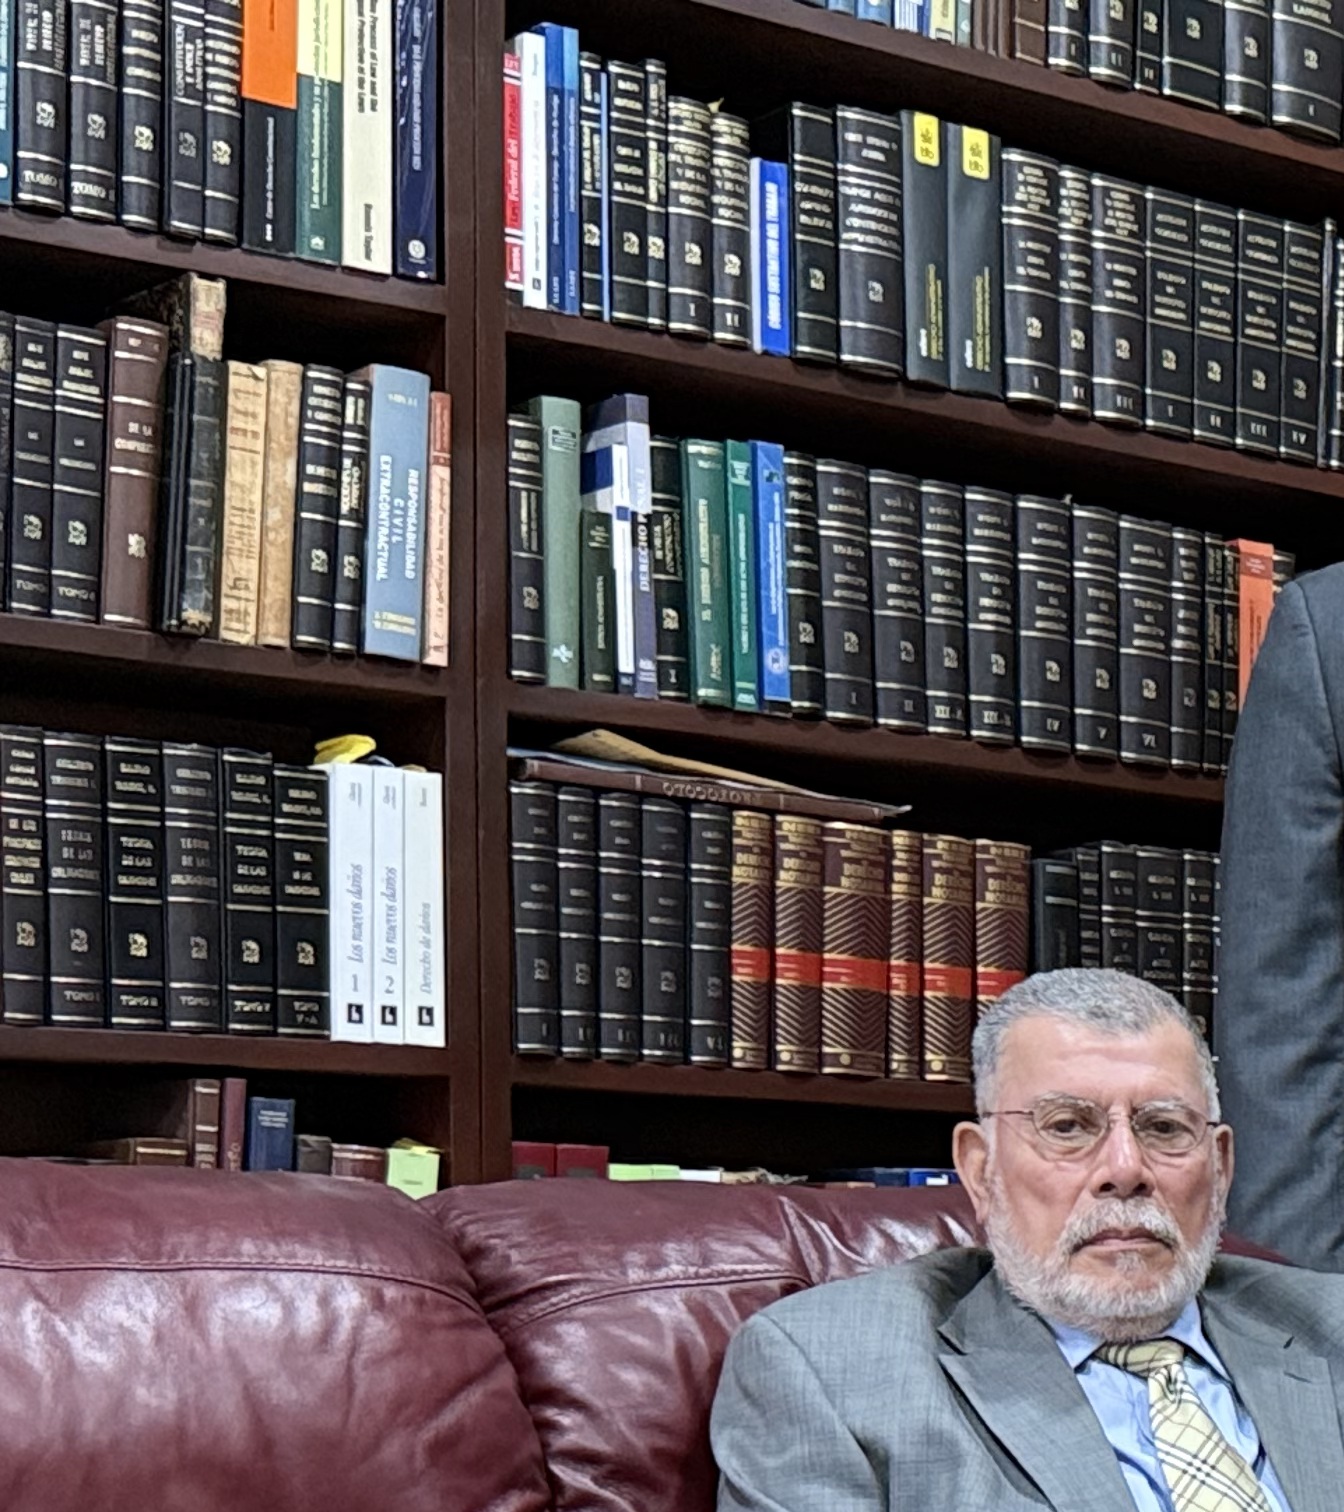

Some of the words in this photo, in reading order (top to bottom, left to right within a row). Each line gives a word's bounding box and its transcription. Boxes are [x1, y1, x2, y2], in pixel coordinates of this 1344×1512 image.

[507, 161, 518, 201] Federal
[376, 455, 392, 582] EXTRACONTRACTUAL
[391, 498, 405, 544] CIVIL
[404, 469, 420, 580] RESPONSABILIDAD
[637, 525, 651, 591] DERECHO
[348, 944, 363, 963] Los
[382, 947, 397, 965] Los
[421, 931, 431, 949] de
[419, 951, 432, 994] Derecho
